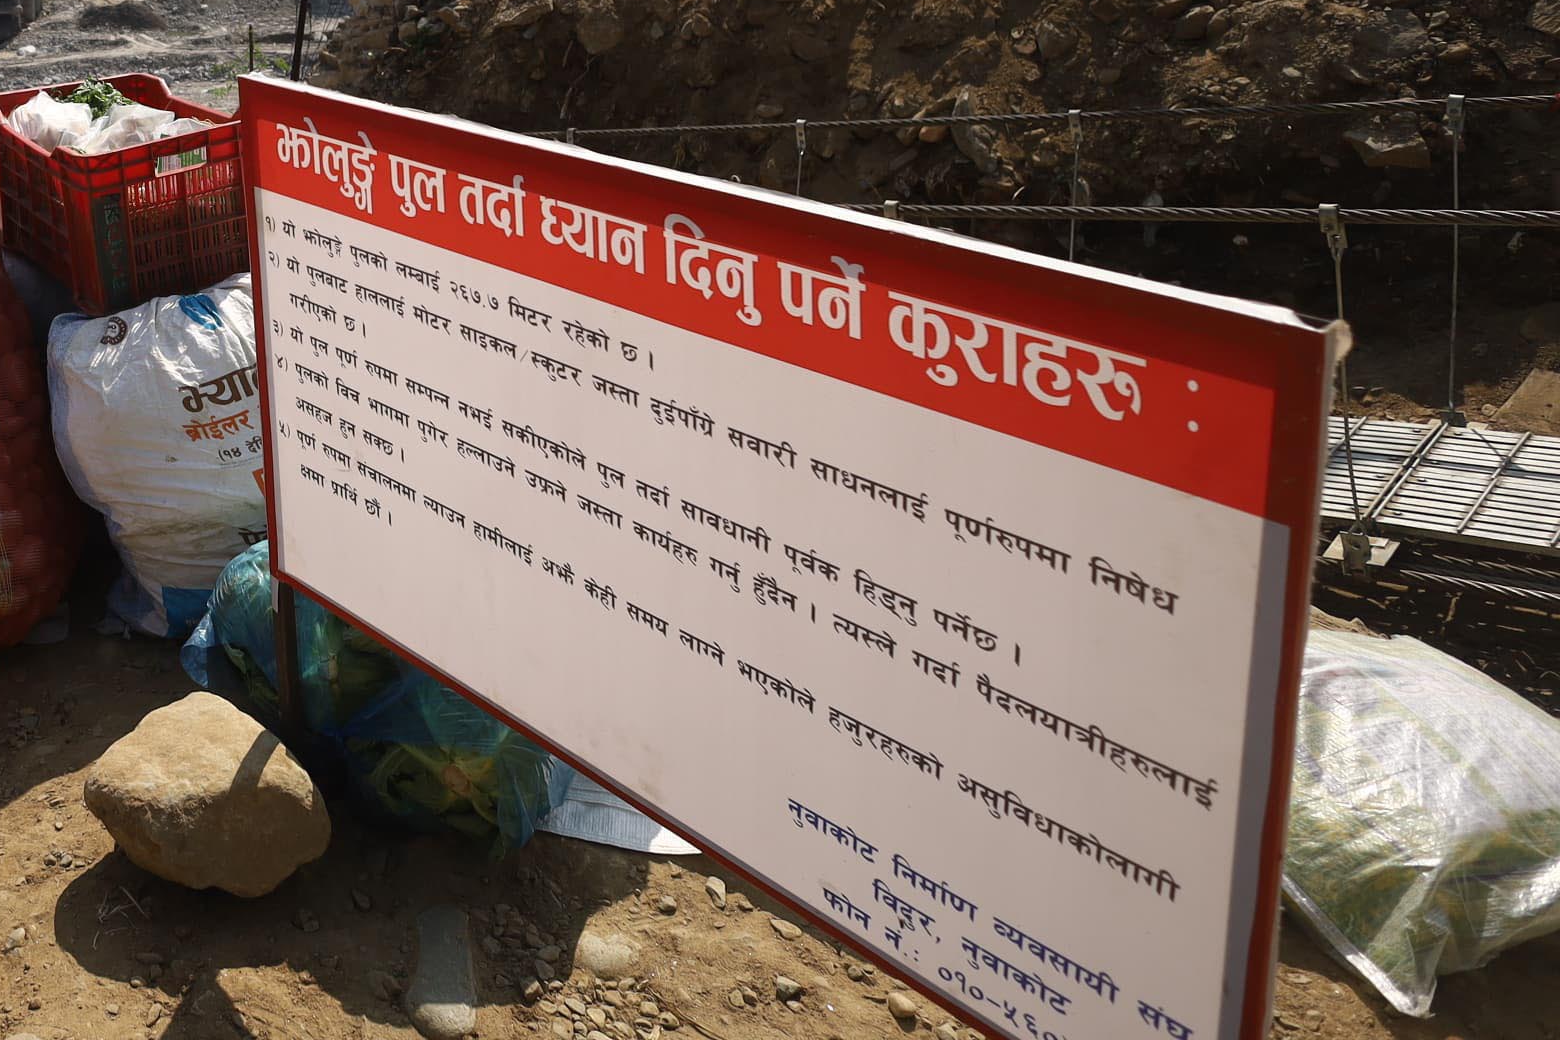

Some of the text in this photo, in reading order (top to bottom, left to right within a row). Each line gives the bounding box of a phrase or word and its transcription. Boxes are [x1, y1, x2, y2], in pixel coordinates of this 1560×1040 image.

[276, 118, 378, 215] झोलुङ्गे
[387, 153, 447, 218] पुल
[457, 173, 527, 238] तर्दा
[539, 195, 648, 275] ध्यान
[662, 213, 763, 327] दिनु
[776, 255, 867, 340] पर्ने
[281, 219, 297, 239] यो
[348, 244, 389, 273] पुलको
[394, 260, 441, 295] लम्बाई
[449, 280, 500, 311] २६७.७
[506, 295, 553, 334] मिटर
[560, 319, 611, 353] रहेको
[288, 292, 338, 325] गरीएको
[285, 255, 301, 276] यो
[305, 264, 349, 294] पुलबाट
[353, 283, 406, 319] हाललाई
[412, 304, 453, 337] मोटर
[591, 373, 641, 409] जस्ता
[727, 426, 799, 470] सवारी
[809, 457, 930, 524] साधनलाई
[1087, 555, 1180, 616] निषेध
[289, 324, 304, 345] यो
[309, 335, 329, 358] पुल
[334, 346, 359, 369] पूर्ण
[404, 376, 451, 411] सम्पन्न
[457, 400, 494, 432] नभई
[500, 418, 588, 472] सकीएकोले
[595, 461, 627, 490] पुल
[635, 479, 671, 510] तर्दा
[679, 498, 773, 555] सावधानी
[783, 543, 841, 583] पूर्वक
[852, 568, 919, 628] हिड्नु
[932, 608, 999, 653] पर्नेछ
[295, 396, 334, 427] असहज
[338, 417, 357, 440] हुन
[361, 428, 394, 456] सक्छ
[300, 463, 326, 489] क्षमा
[294, 362, 330, 391] पुलको
[334, 376, 361, 406] विच
[367, 396, 411, 429] भागमा
[416, 419, 450, 449] पुगेर
[456, 437, 517, 479] हल्लाउने
[576, 493, 624, 530] जस्ता
[708, 555, 741, 594] गर्नु
[752, 571, 799, 613] हुँदैन
[831, 612, 898, 660] त्यस्ले
[911, 649, 962, 689] गर्दा
[356, 458, 417, 505] संचालनमा
[422, 494, 467, 529] ल्याउन
[472, 520, 534, 568] हामीलाई
[541, 556, 576, 586] अझै
[583, 576, 618, 612] केही
[625, 600, 670, 638] समय
[678, 628, 726, 668] लाग्ने
[736, 659, 817, 715] भएकोले
[956, 772, 1182, 903] असुविधाकोलागी
[787, 797, 1195, 1040] नुवाकोट निर्माण व्यवसायी संघ
[821, 886, 872, 931] फोन
[937, 966, 1067, 1040] ०१०-५६०
[960, 935, 1073, 1016] नुवाकोट
